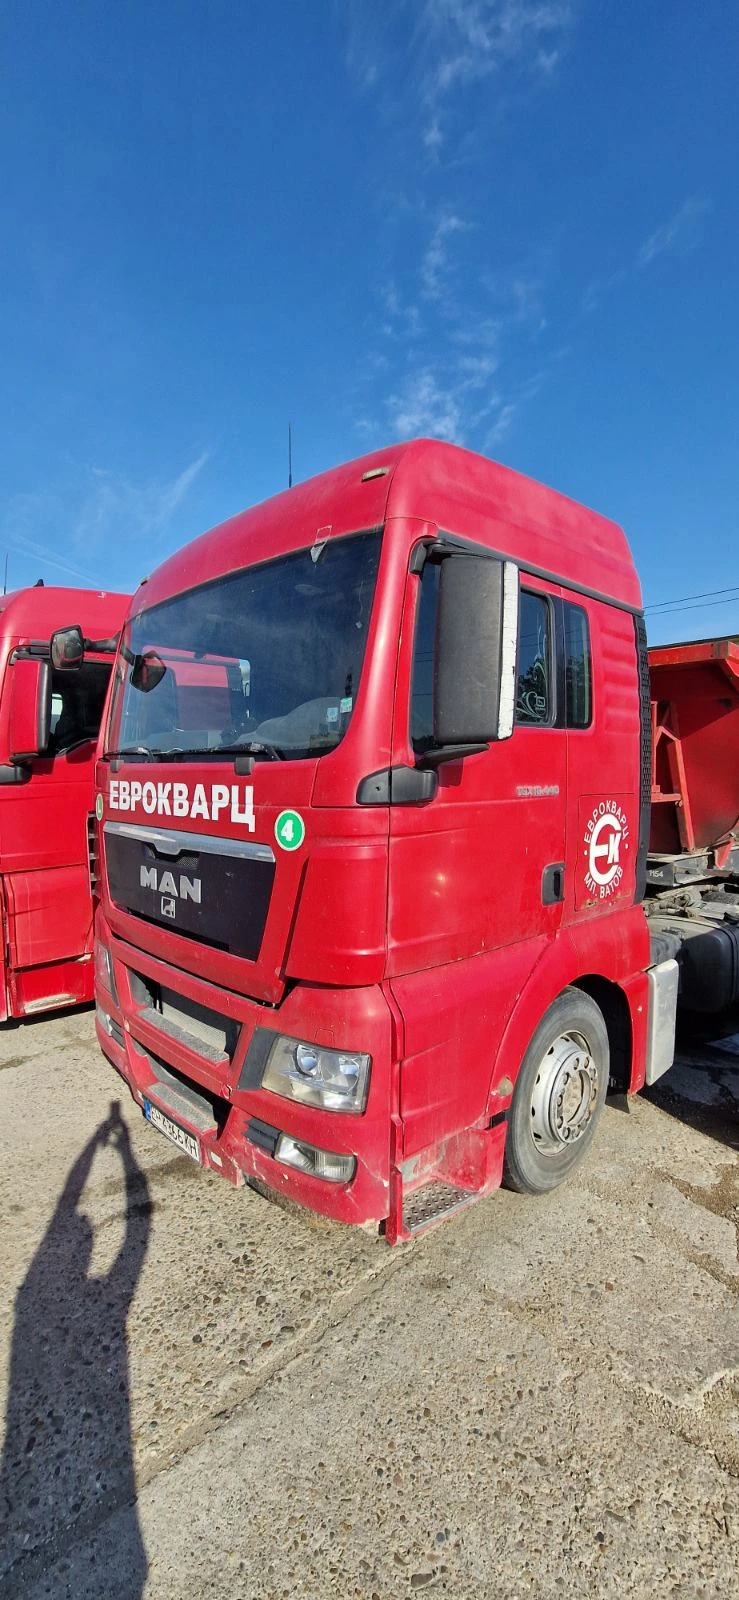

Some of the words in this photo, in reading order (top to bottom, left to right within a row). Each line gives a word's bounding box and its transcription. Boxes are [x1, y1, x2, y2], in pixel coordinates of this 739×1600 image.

[109, 780, 256, 833] ЕВРОКВАРЦ
[584, 800, 629, 843] ЕВРОКВАРЦ
[280, 819, 295, 842] 4
[140, 865, 202, 904] MAN
[600, 866, 623, 898] ВАТОВ
